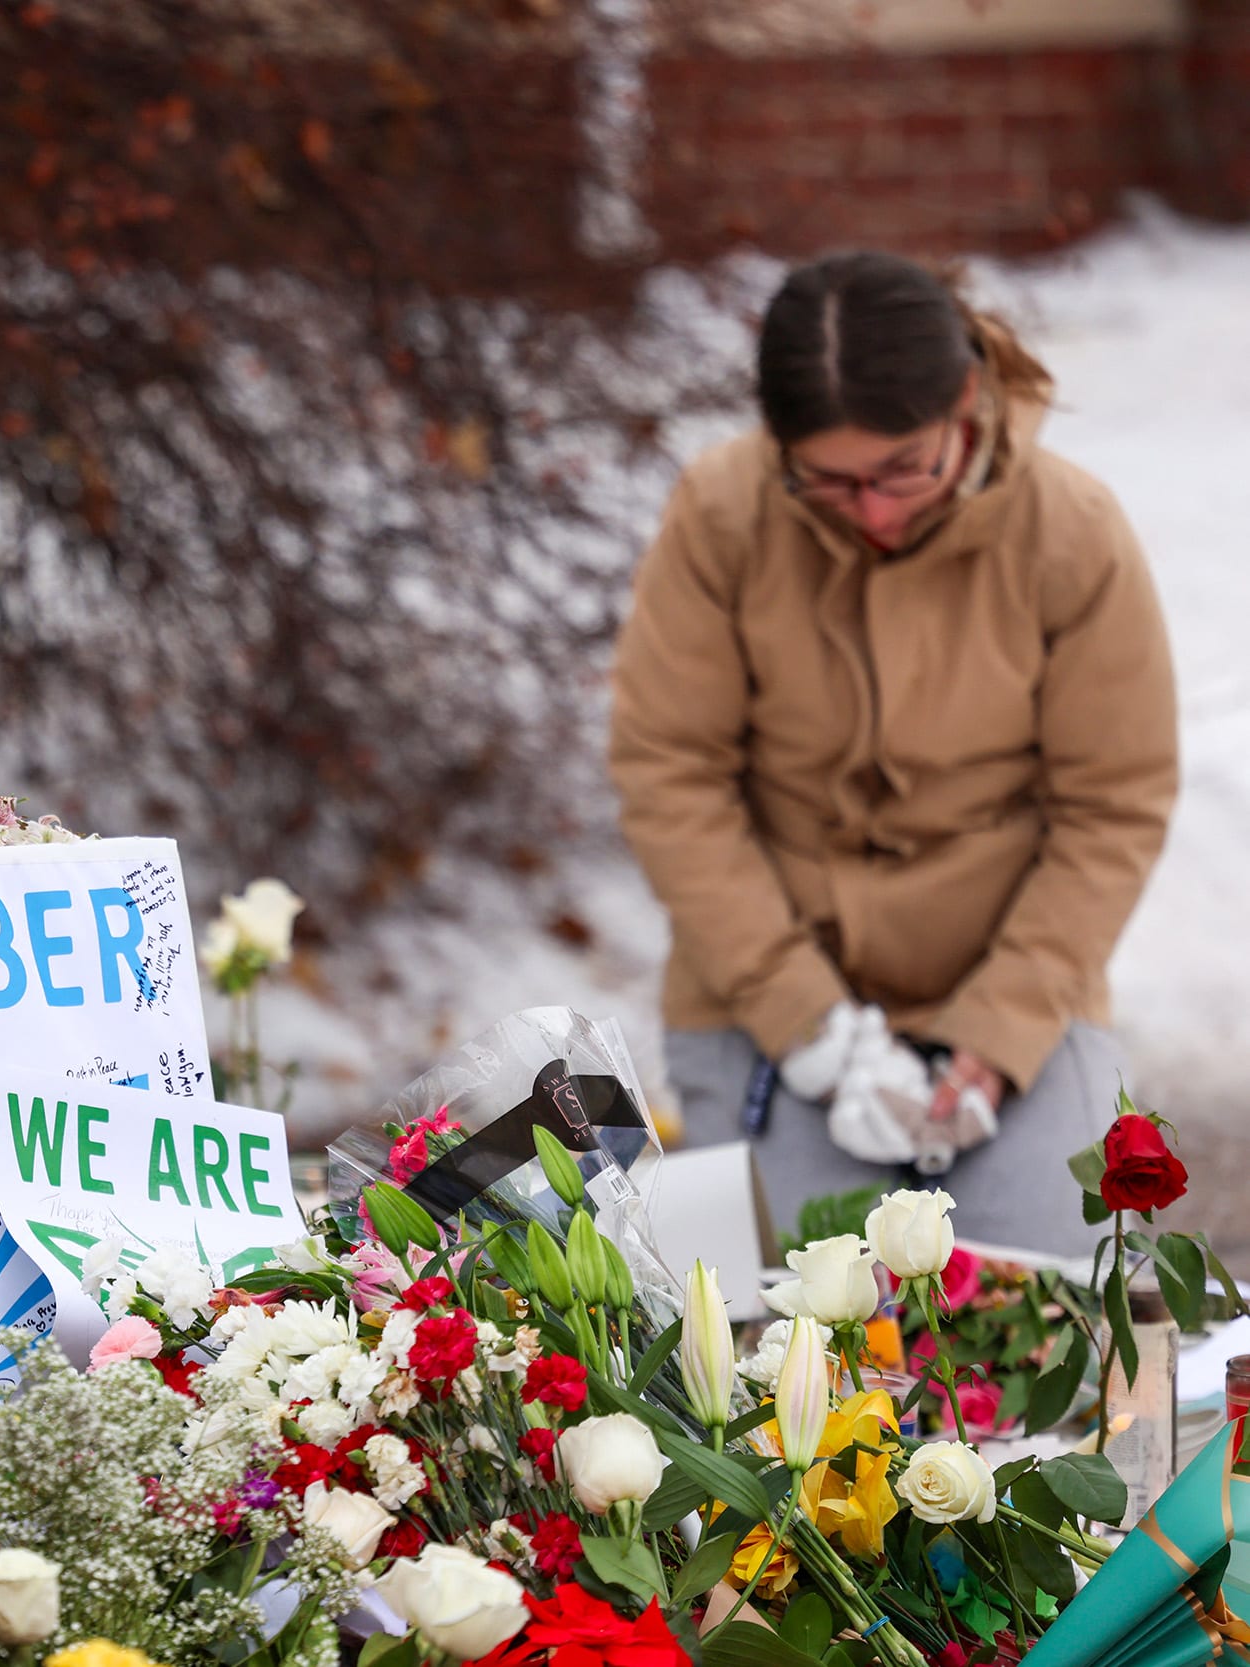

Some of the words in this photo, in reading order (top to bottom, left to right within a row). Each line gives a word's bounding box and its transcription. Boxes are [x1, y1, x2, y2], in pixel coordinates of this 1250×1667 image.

[94, 1056, 118, 1076] Peace
[7, 1092, 115, 1195] WE
[148, 1117, 284, 1218] ARE
[38, 1192, 94, 1220] Thank
